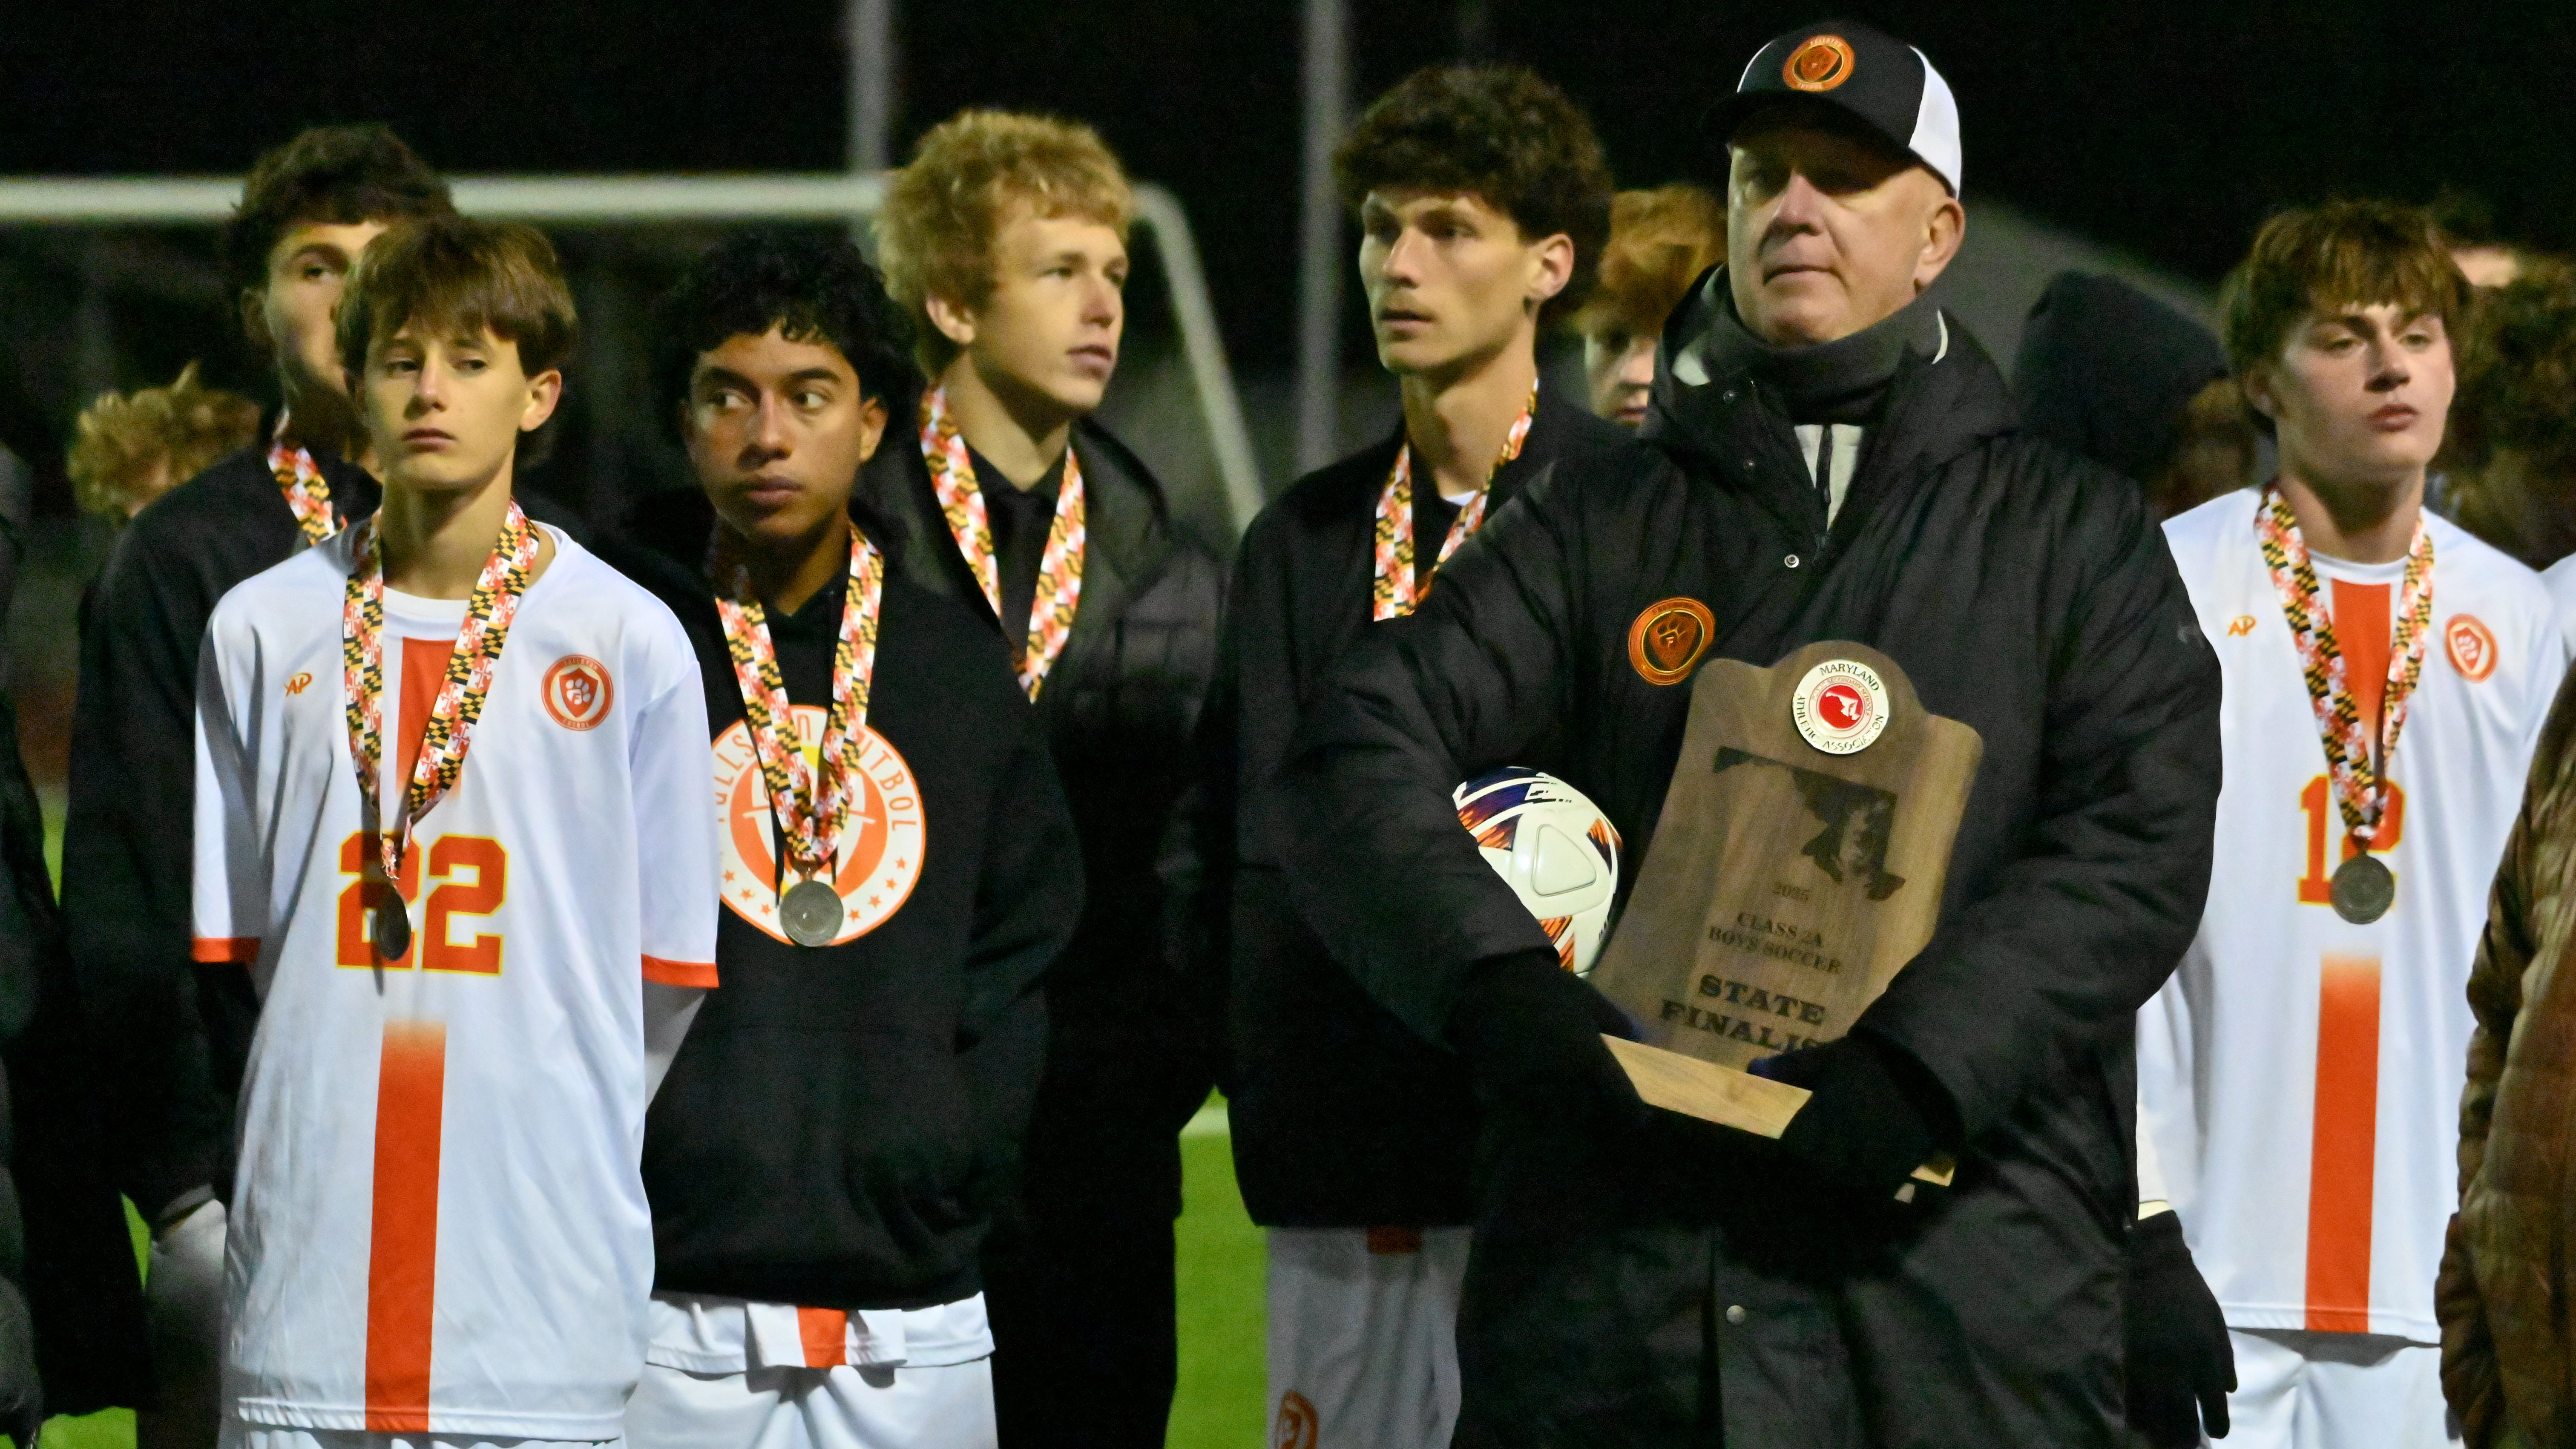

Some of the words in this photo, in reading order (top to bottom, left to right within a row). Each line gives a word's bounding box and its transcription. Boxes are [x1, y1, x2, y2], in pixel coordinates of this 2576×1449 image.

[1820, 663, 1879, 690] MARYLAND
[1822, 714, 1884, 751] ASSOCIAON
[336, 830, 509, 977] 22
[1709, 925, 1759, 951] BOYS
[1763, 941, 1841, 974] SOCCER
[1736, 912, 1797, 937] CLASS
[1801, 930, 1822, 947] 2A
[1699, 974, 1826, 1025] STATE
